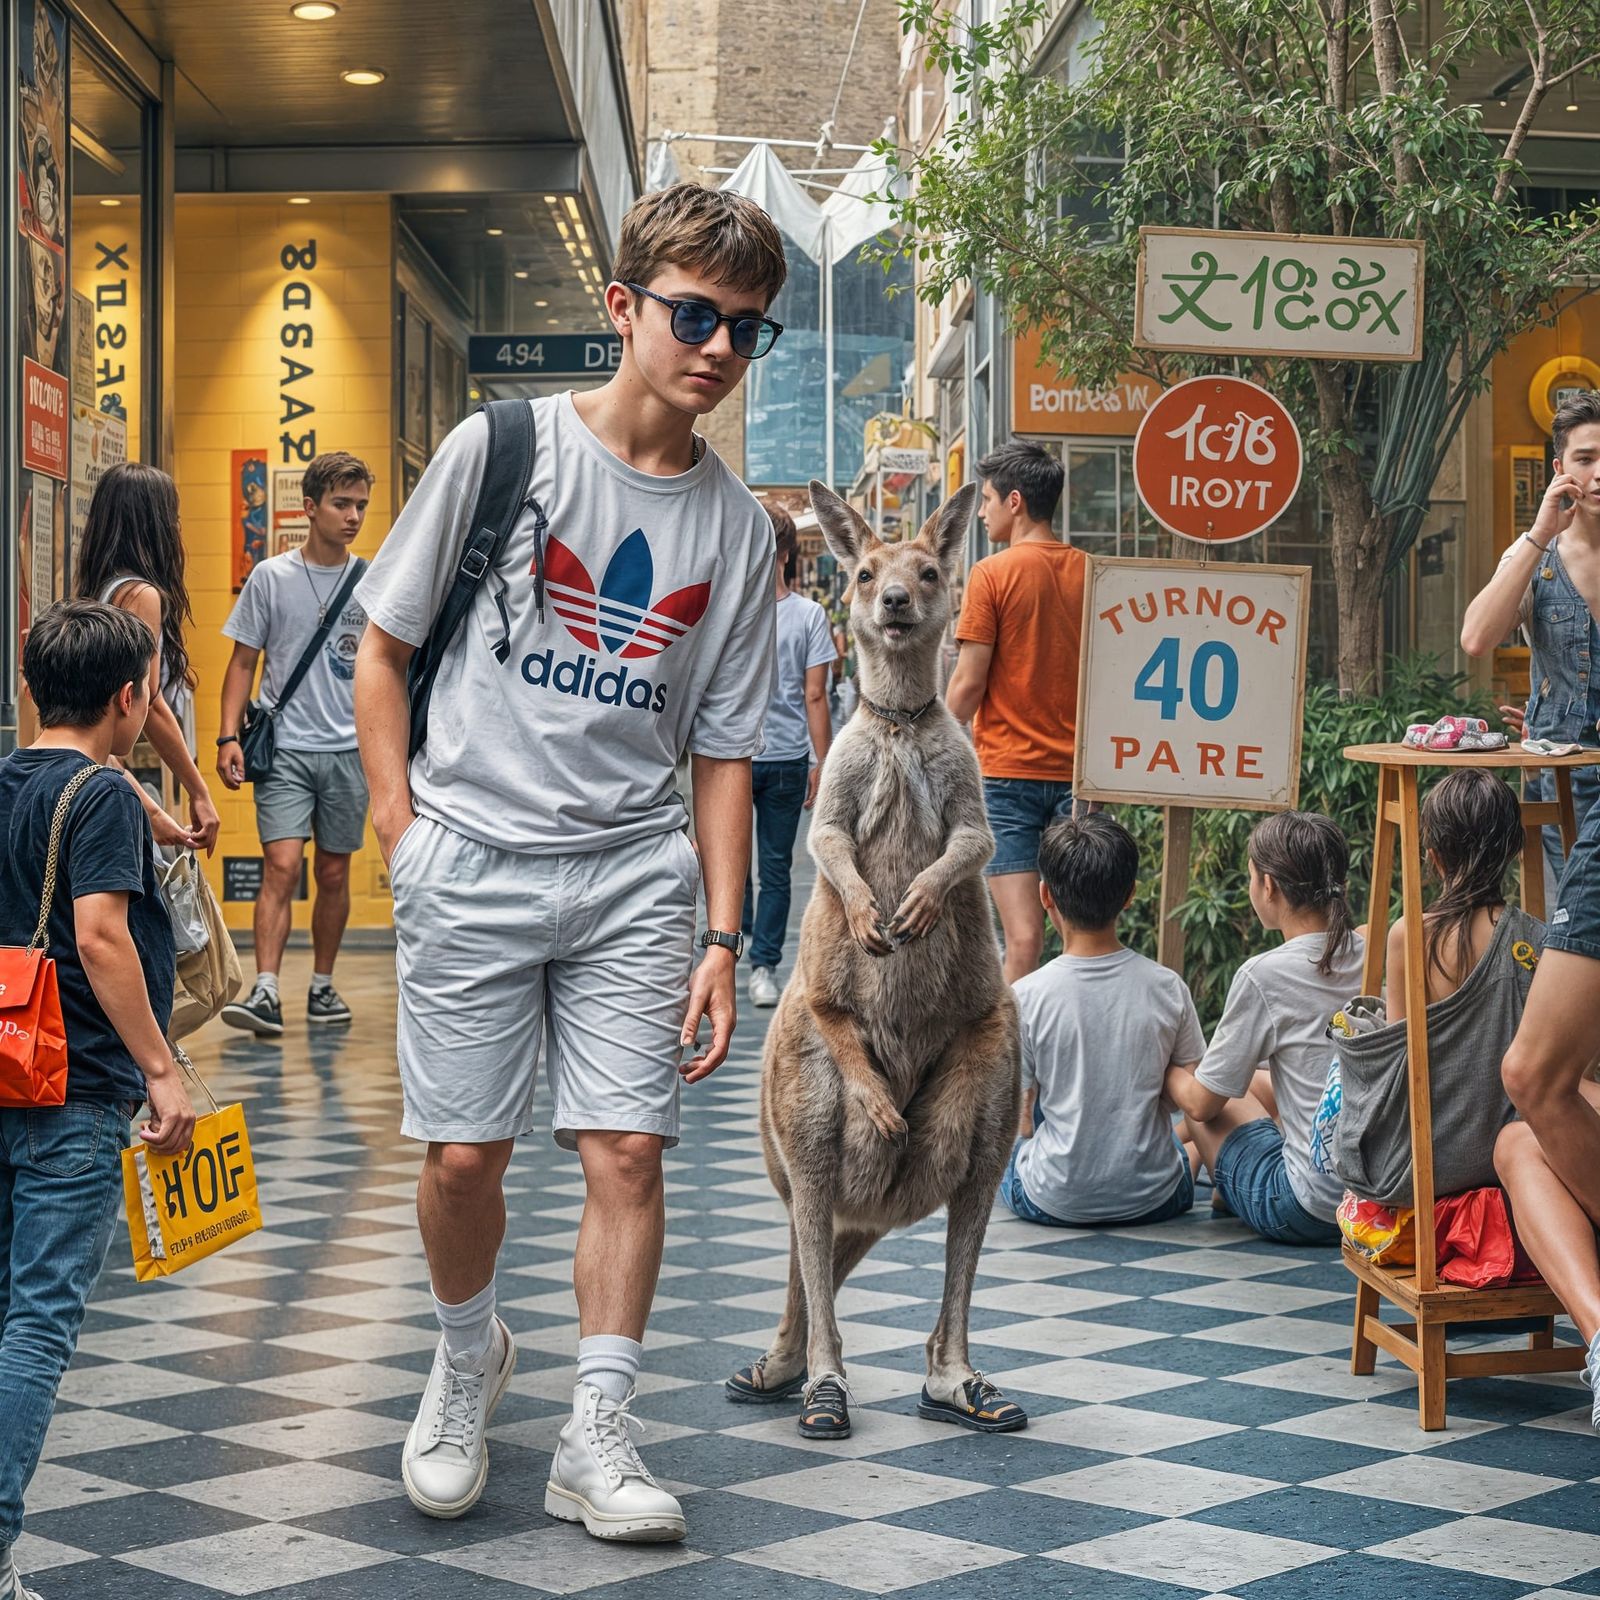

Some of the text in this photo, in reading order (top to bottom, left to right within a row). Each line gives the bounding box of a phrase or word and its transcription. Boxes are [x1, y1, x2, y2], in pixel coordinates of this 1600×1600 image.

[1099, 586, 1287, 645] TURNOR
[1134, 637, 1239, 721] 40
[1110, 736, 1264, 779] PARE
